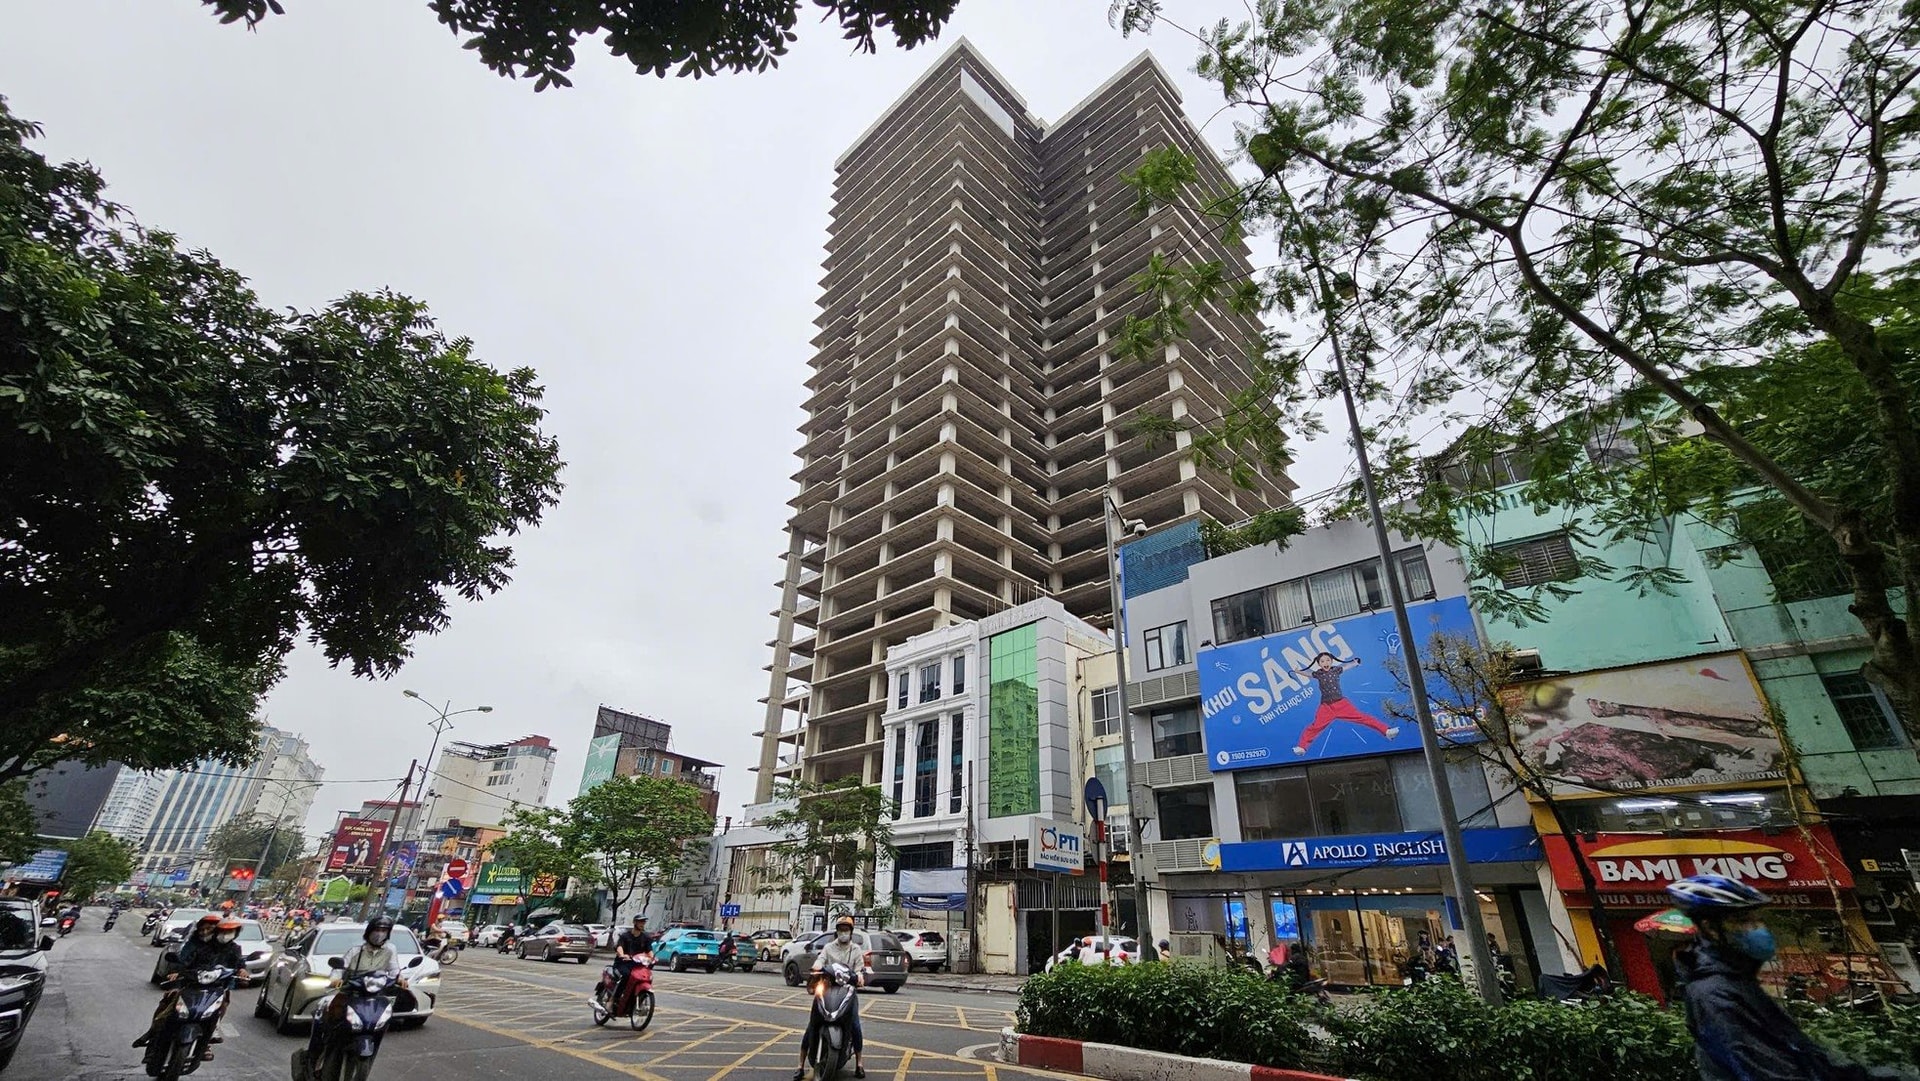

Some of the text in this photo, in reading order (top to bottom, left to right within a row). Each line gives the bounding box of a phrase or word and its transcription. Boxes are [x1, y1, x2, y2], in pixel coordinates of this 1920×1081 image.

[1236, 623, 1354, 715] SÁNG
[1059, 833, 1079, 852] PTI
[1313, 843, 1367, 860] APOLLO
[1373, 840, 1445, 857] ENGLISH
[1596, 855, 1789, 882] BAMI KING
[1866, 861, 1875, 870] 5
